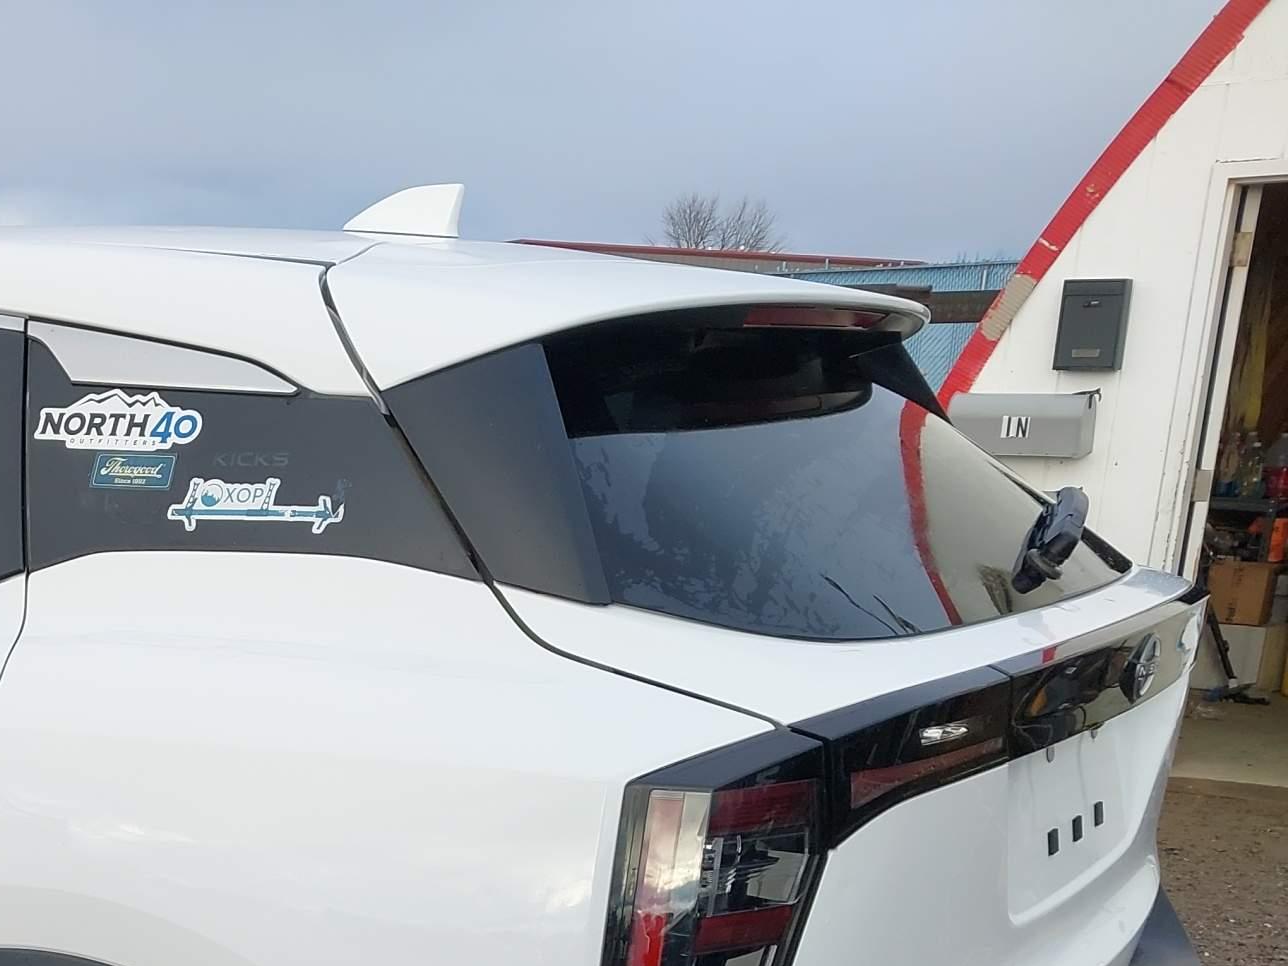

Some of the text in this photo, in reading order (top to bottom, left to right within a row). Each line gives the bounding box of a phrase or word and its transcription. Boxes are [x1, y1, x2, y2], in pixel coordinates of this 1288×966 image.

[1005, 416, 1029, 438] IN
[69, 437, 157, 447] OUTFITTERS
[214, 451, 290, 467] KICKS
[223, 487, 265, 504] XOP
